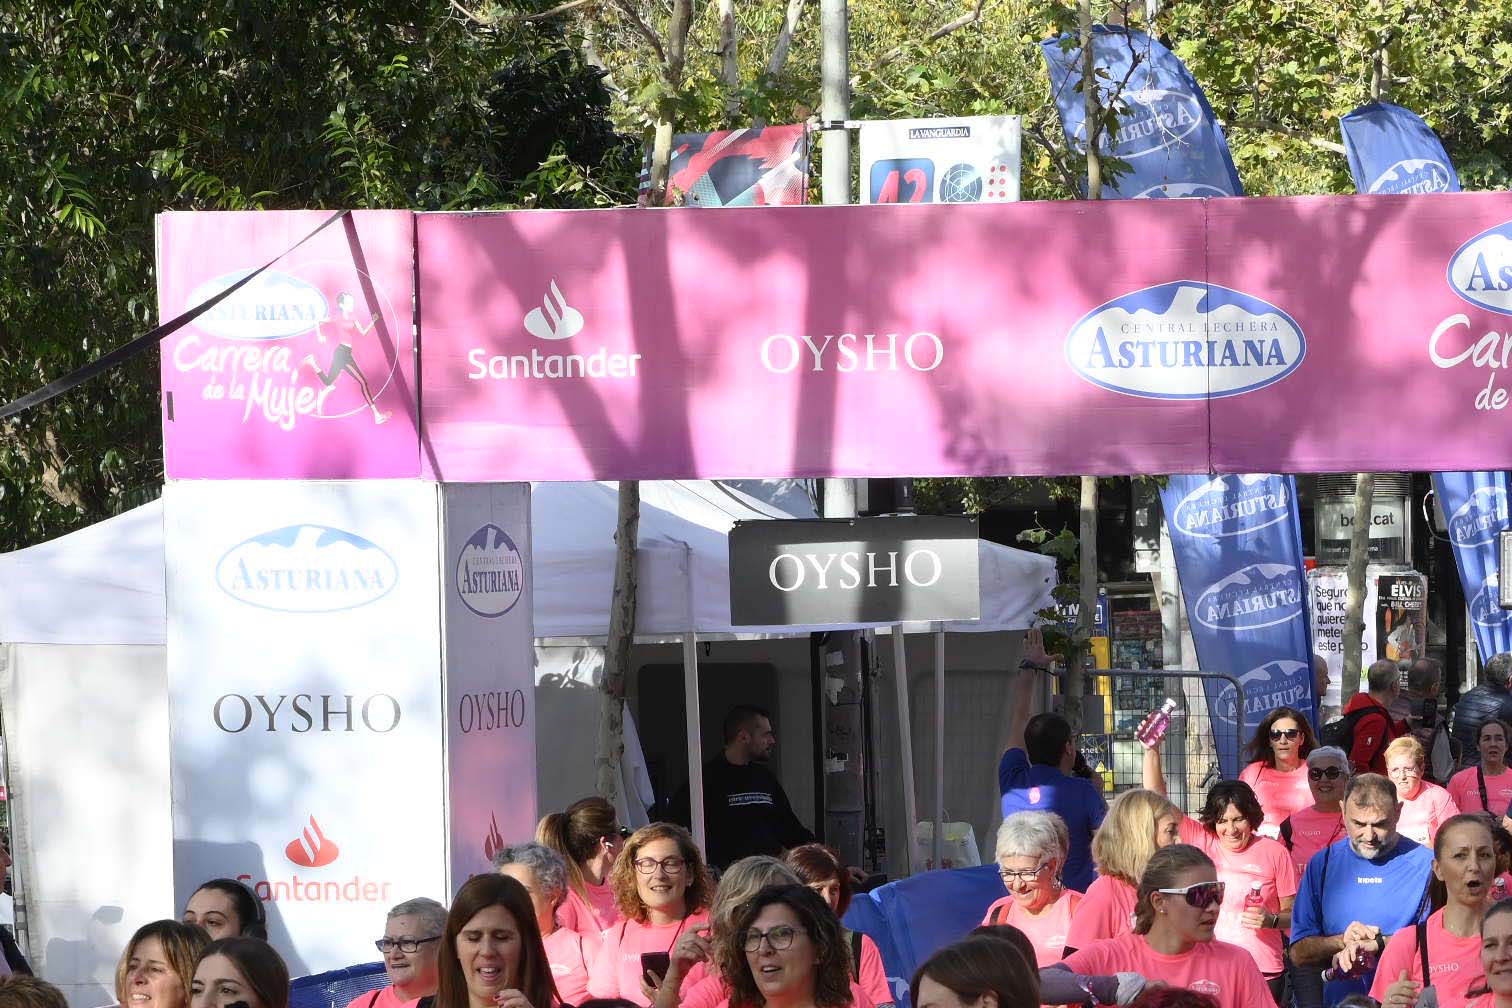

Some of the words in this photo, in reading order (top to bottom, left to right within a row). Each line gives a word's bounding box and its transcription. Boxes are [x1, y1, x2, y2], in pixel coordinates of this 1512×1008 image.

[1121, 322, 1196, 334] CENTRAL
[1204, 320, 1278, 333] LECHERA
[173, 335, 292, 373] Carrera
[467, 347, 642, 380] Santander
[760, 332, 944, 374] OYSHO
[1087, 326, 1287, 368] ASTURIANA
[203, 372, 224, 400] de
[229, 377, 246, 400] la
[243, 370, 336, 431] Mujer
[1474, 371, 1509, 410] de
[232, 558, 385, 591] ASTURIANA
[462, 561, 520, 594] ASTURIANA
[769, 549, 943, 592] OYSHO
[1391, 584, 1422, 596] ELVIS
[1318, 640, 1337, 651] este
[213, 693, 402, 733] OYSHO
[459, 689, 525, 733] OYSHO
